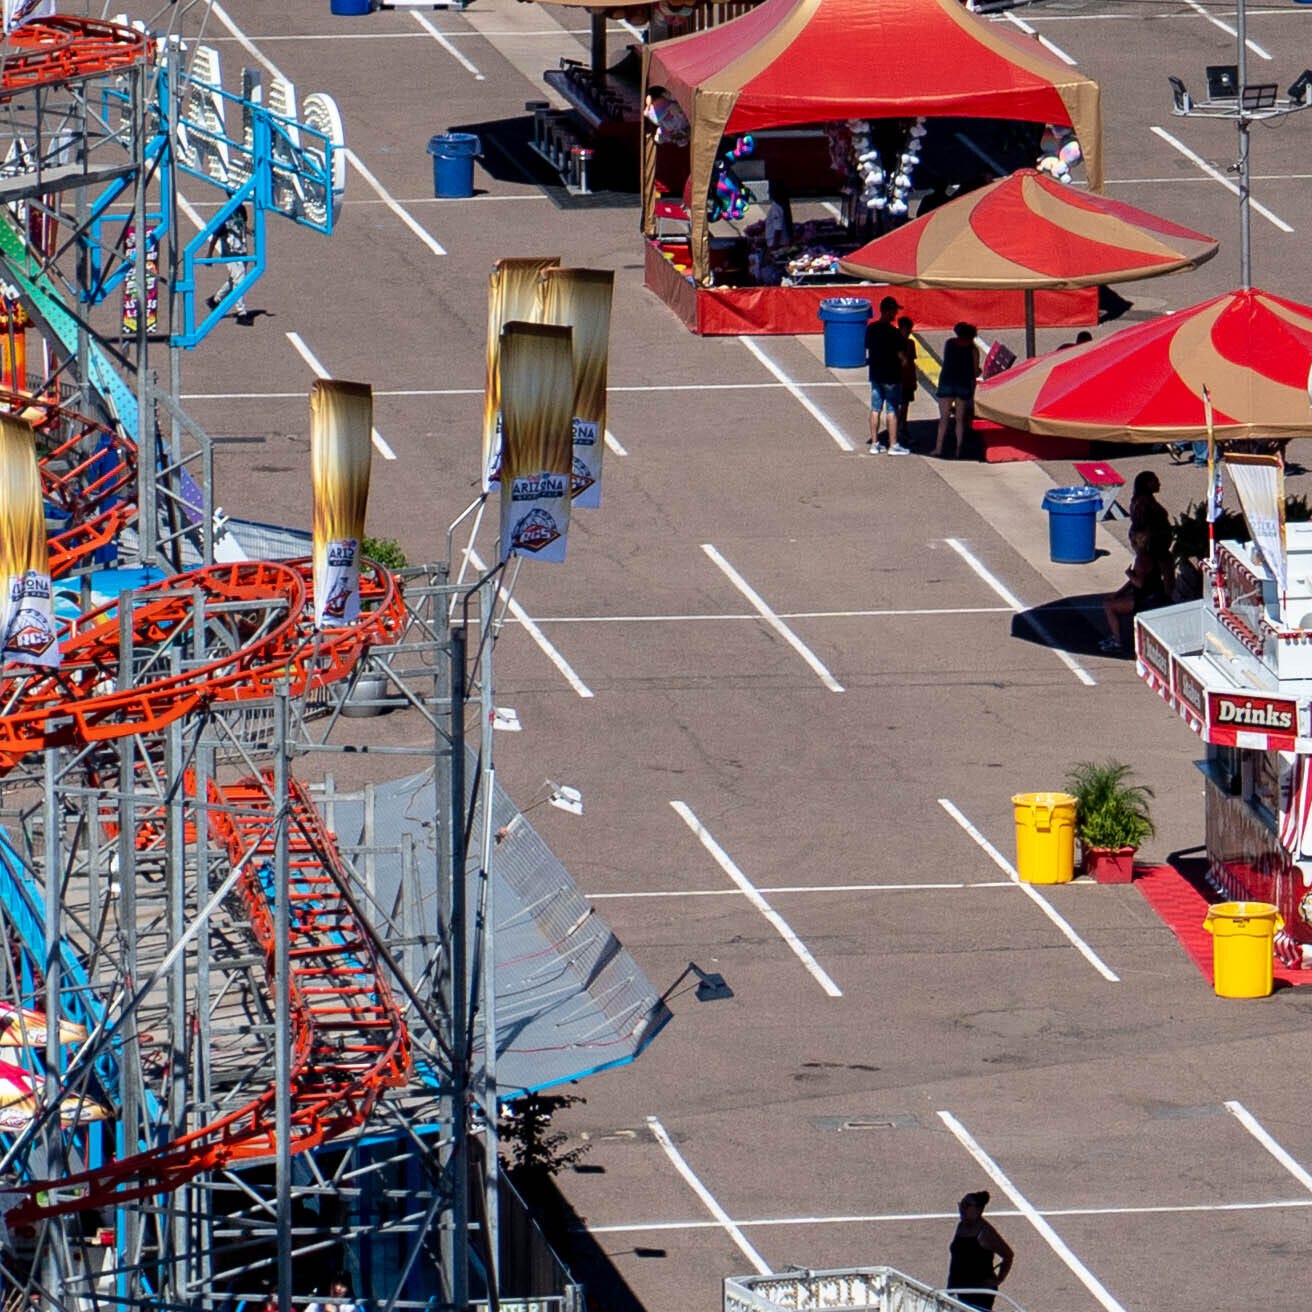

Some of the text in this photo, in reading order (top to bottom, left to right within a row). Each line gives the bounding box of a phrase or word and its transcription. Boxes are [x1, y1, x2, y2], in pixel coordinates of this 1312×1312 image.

[512, 479, 564, 494] ARIZONA
[17, 631, 50, 647] RCS
[1218, 699, 1292, 728] Drinks
